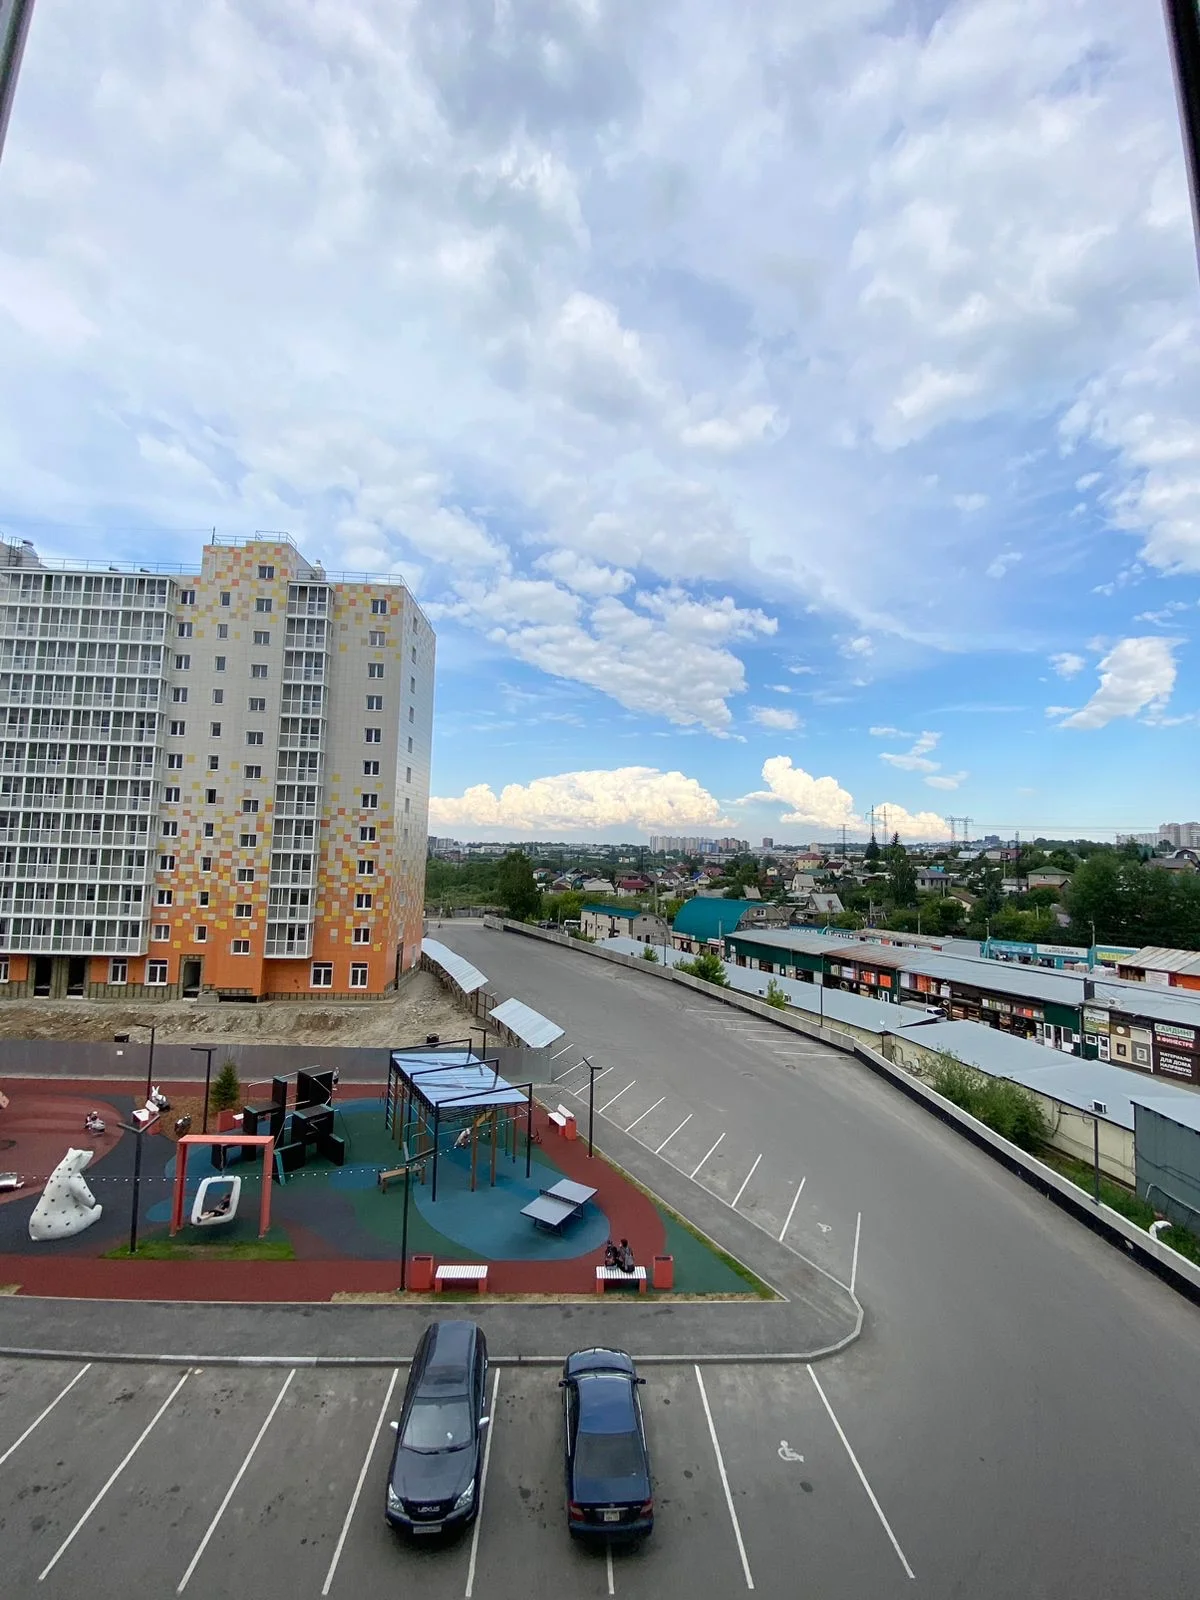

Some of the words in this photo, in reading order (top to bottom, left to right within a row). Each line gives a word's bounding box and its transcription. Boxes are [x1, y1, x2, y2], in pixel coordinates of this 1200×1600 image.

[1155, 1024, 1193, 1038] САЙДИНГ
[1160, 1051, 1191, 1062] МАТЕРИАЛЫ
[1160, 1056, 1172, 1064] ДЛЯ
[1172, 1059, 1192, 1068] ДОМА
[1160, 1062, 1192, 1073] НАПРЯМУЮ
